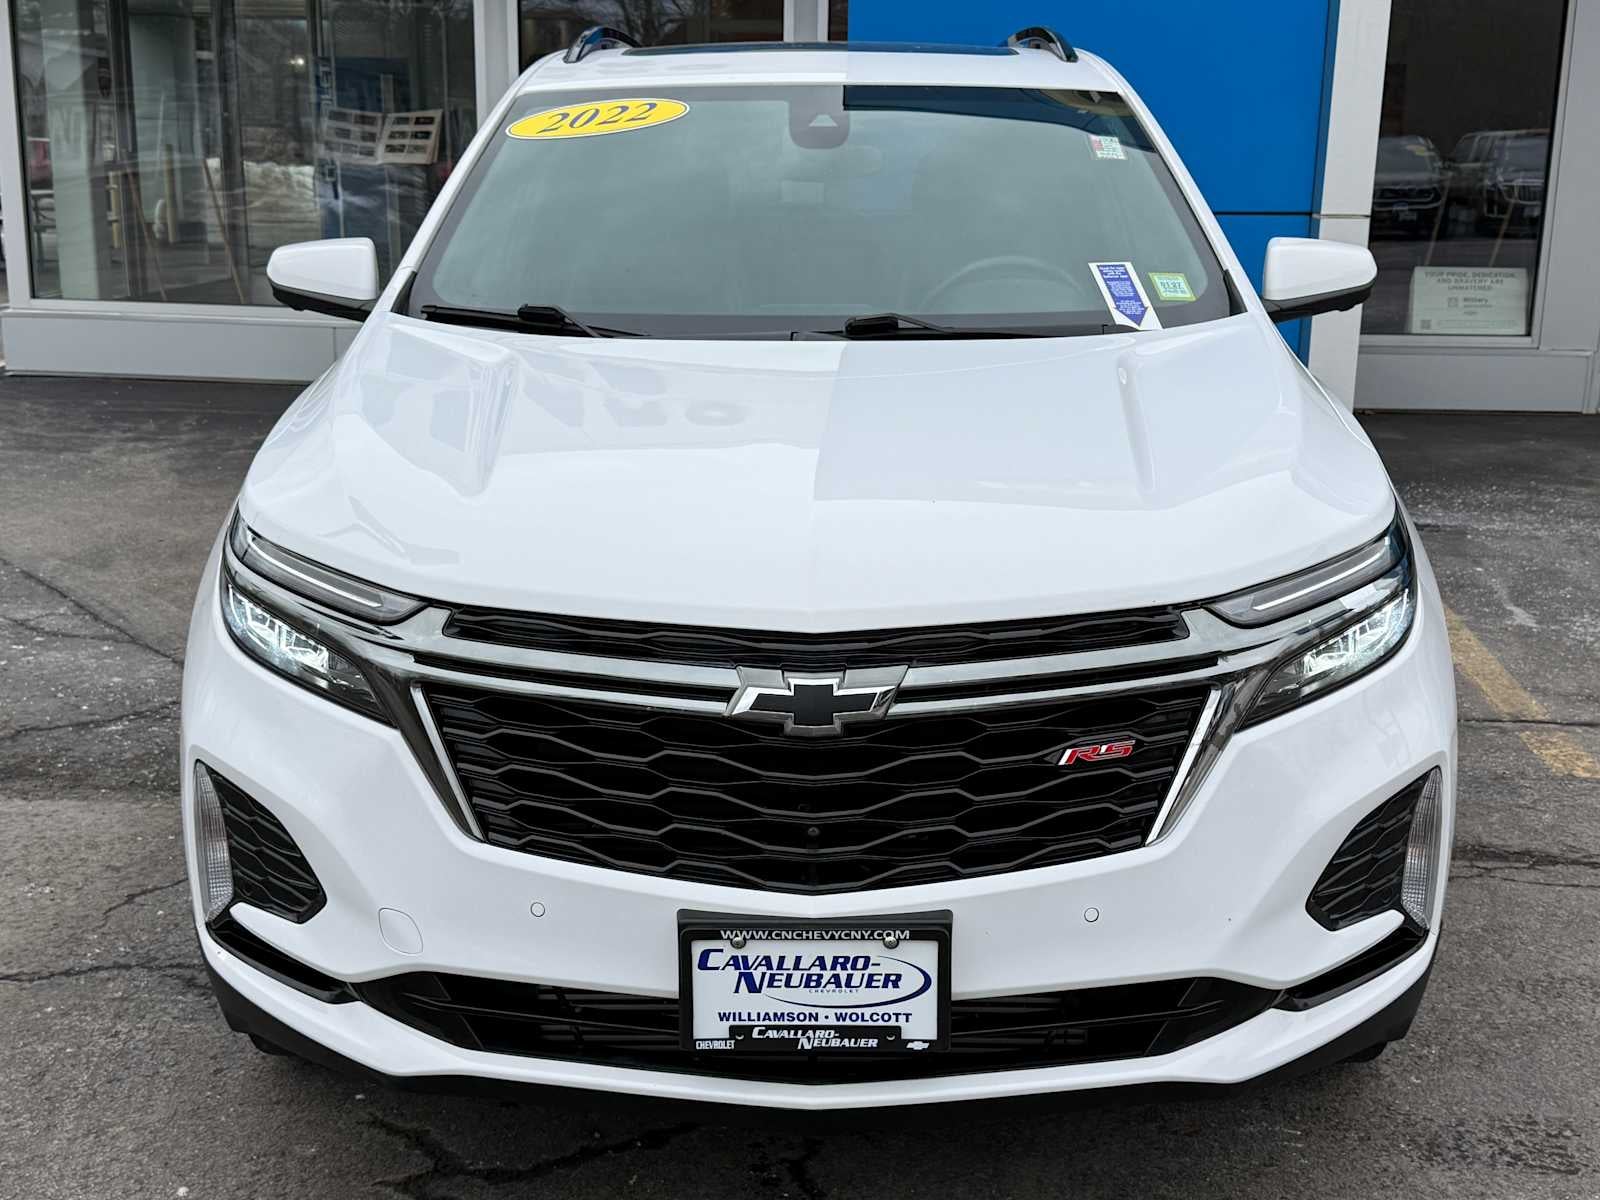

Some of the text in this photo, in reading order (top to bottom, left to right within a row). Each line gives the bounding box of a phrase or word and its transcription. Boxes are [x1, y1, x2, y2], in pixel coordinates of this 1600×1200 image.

[536, 102, 658, 135] 2022
[1057, 740, 1136, 766] RS
[720, 929, 910, 941] WWW.CNCHEVYCNY.COM
[697, 948, 881, 971] CAVALLARO-
[733, 971, 903, 994] NEUBAUER
[718, 1011, 913, 1023] WILLIAMSON WOLCOTT
[751, 1026, 840, 1040] CAVALLARO-
[695, 1039, 735, 1050] CHEVROLET
[797, 1037, 879, 1050] NEUBAUER
